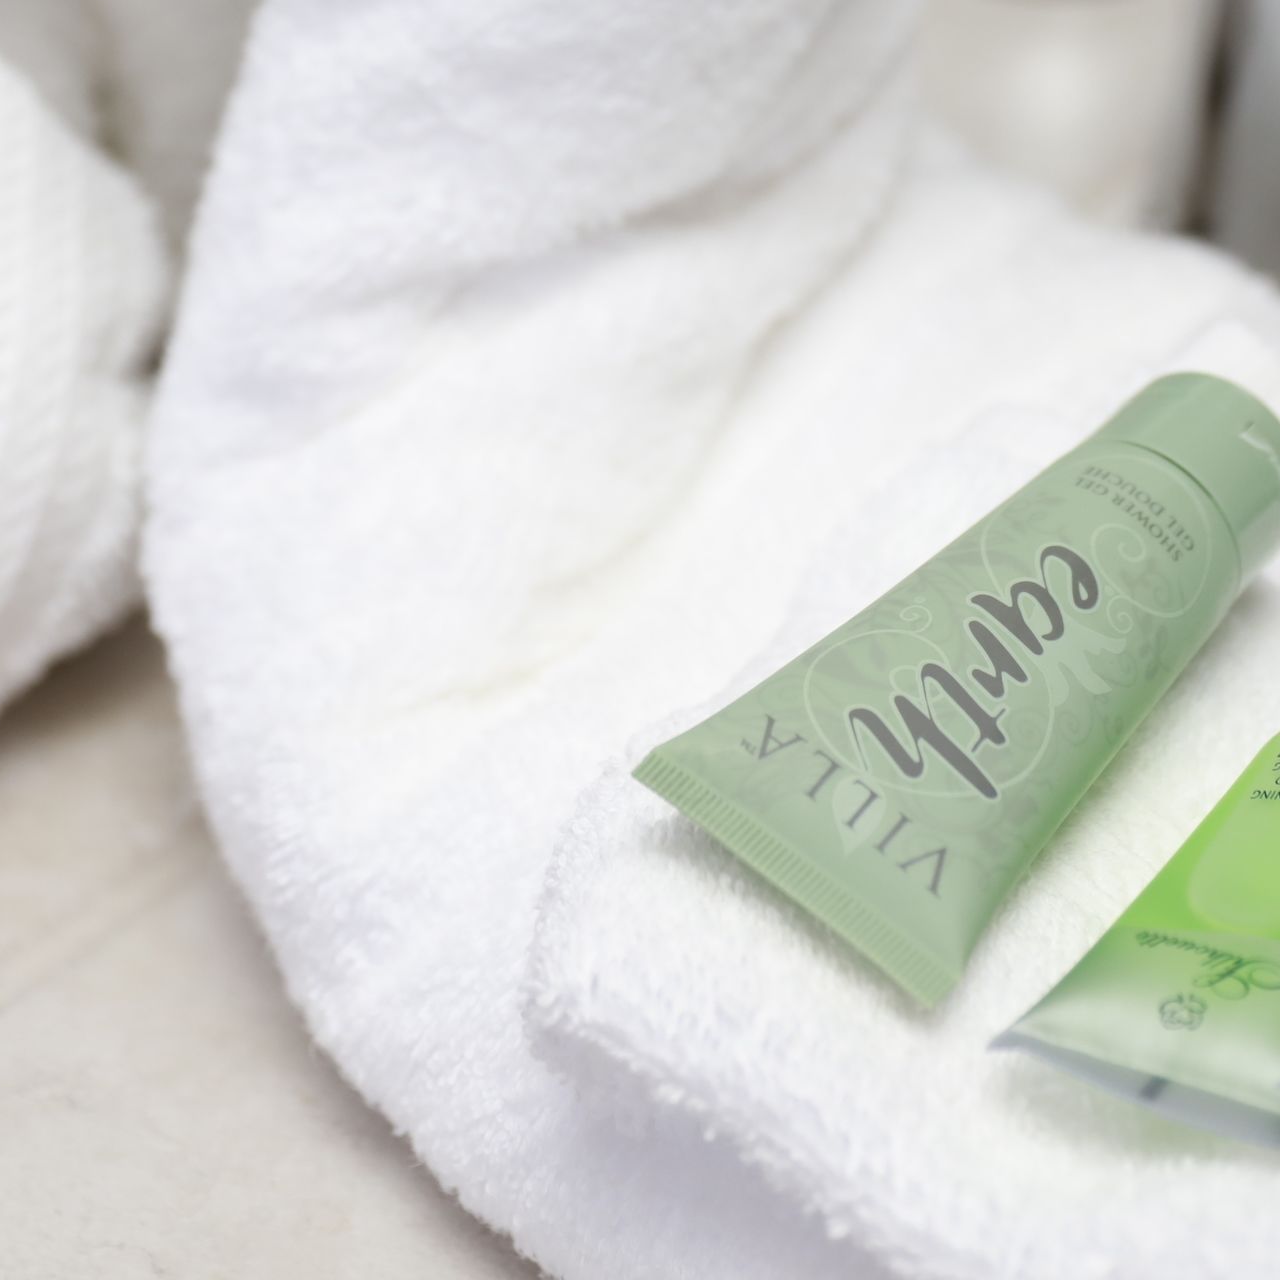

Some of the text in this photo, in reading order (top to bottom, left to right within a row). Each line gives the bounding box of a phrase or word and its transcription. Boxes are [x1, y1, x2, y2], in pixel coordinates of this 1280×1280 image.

[1075, 477, 1184, 561] SHOWER GEL
[1083, 466, 1195, 551] GEL DOUCHE
[848, 545, 1099, 799] earth
